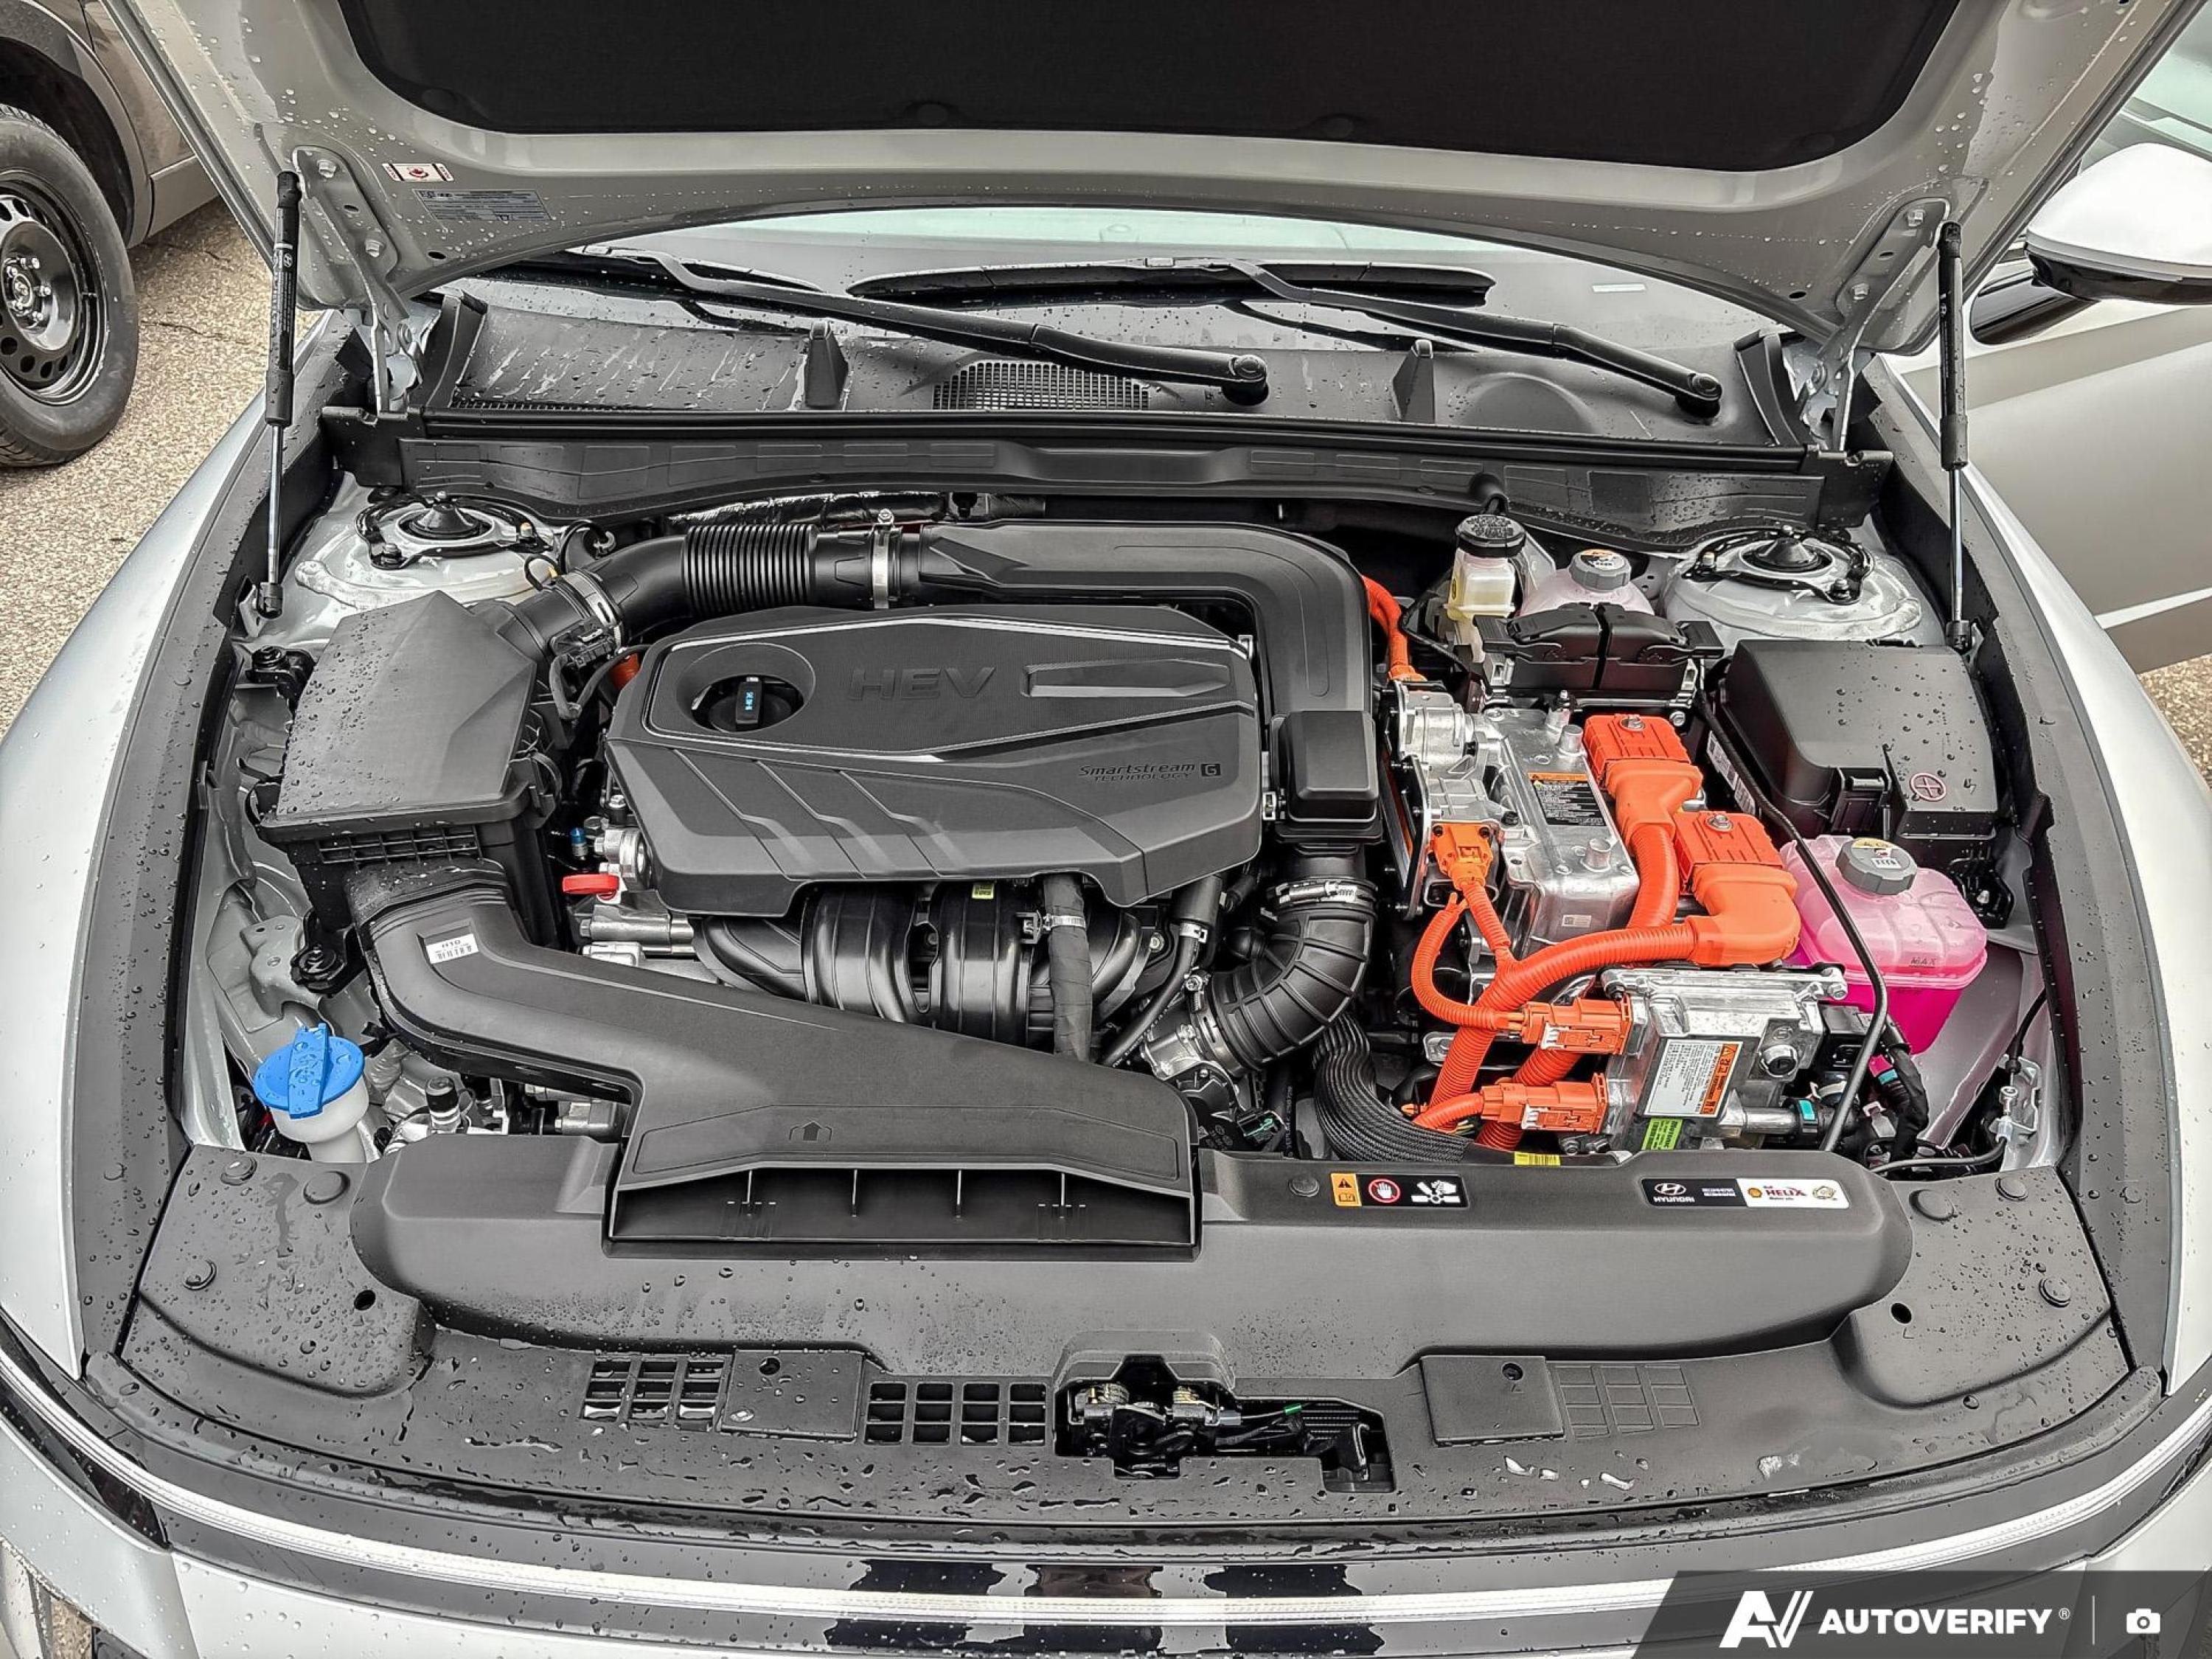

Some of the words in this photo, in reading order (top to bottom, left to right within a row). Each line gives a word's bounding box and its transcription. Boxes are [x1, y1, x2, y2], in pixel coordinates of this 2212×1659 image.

[847, 667, 996, 701] HEV
[1080, 763, 1196, 776] Smartstream
[1765, 1188, 1806, 1197] HELIX
